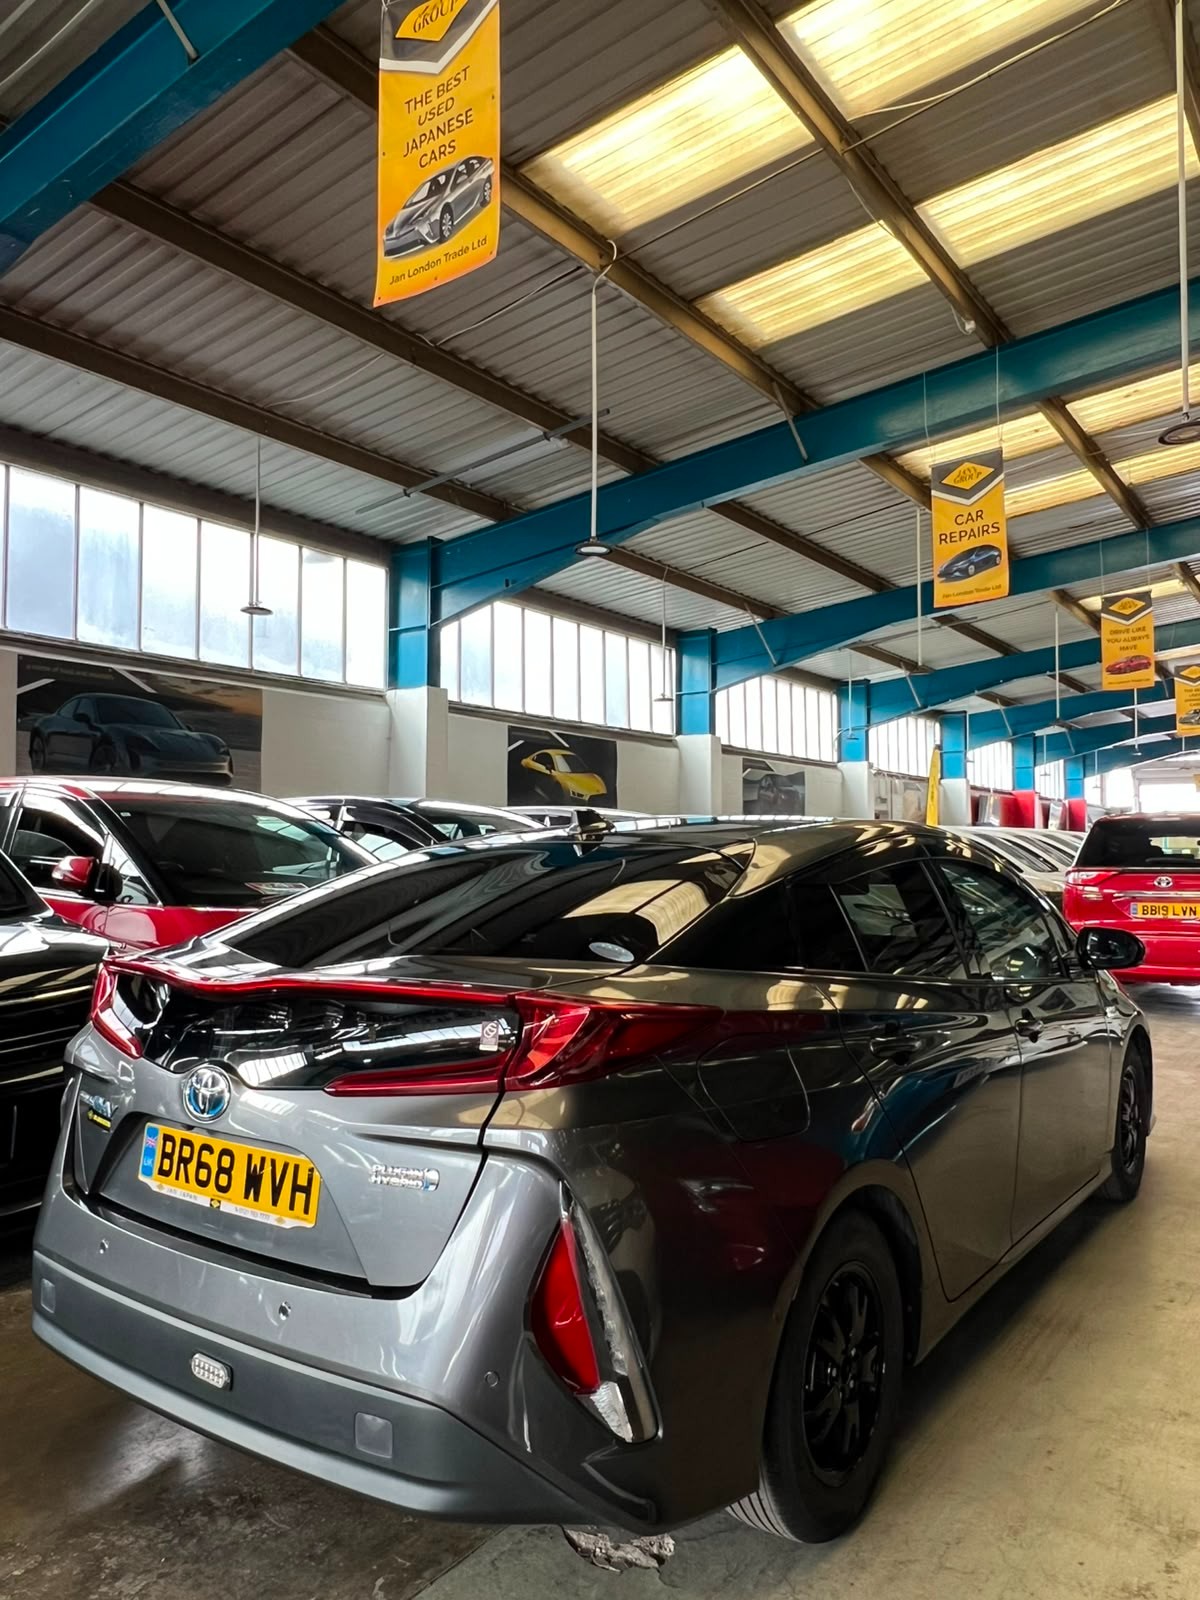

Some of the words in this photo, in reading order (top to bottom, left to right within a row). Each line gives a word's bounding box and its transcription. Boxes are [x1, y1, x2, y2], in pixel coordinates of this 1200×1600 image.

[404, 89, 433, 114] THE
[436, 65, 471, 99] BEST
[418, 96, 455, 126] USED
[403, 107, 474, 158] JAPANESE
[419, 139, 456, 168] CARS
[389, 272, 406, 285] Jan
[407, 258, 442, 278] London
[443, 245, 470, 262] Trade
[471, 235, 488, 251] Ltd
[954, 509, 984, 526] CAR
[938, 522, 1000, 545] REPAIRS
[1109, 627, 1130, 636] DRIVE
[1131, 625, 1146, 633] LIKE
[1122, 633, 1150, 643] ALWAYS
[1142, 905, 1169, 917] BB19
[1172, 905, 1197, 917] LVN
[157, 1133, 234, 1194] BR68
[243, 1153, 314, 1214] WVH
